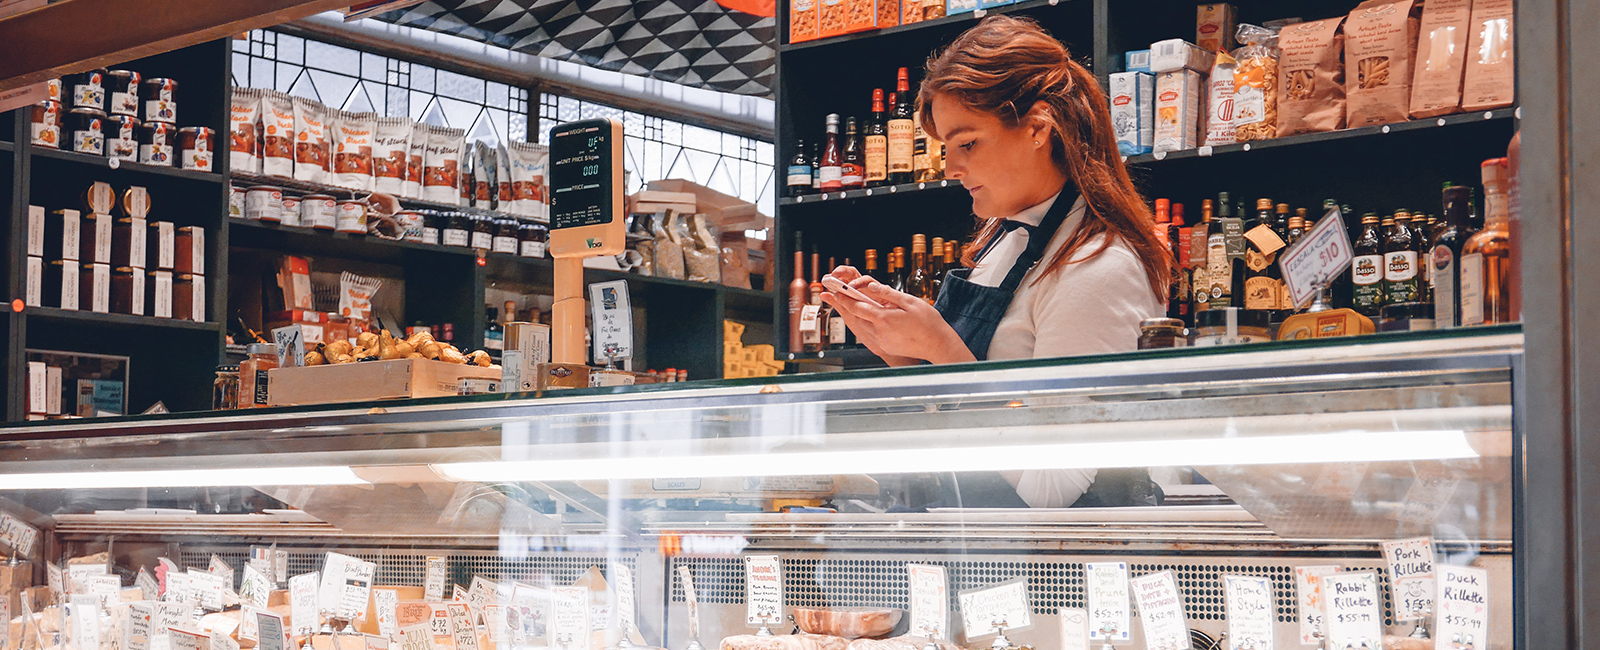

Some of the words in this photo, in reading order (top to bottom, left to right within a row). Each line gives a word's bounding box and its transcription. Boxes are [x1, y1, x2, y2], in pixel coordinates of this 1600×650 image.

[341, 126, 370, 136] Chicken
[551, 197, 557, 205] $
[1319, 241, 1339, 268] $10
[1394, 547, 1421, 561] Pork
[1394, 562, 1432, 578] Rillette
[1446, 572, 1479, 587] Duck
[1094, 586, 1126, 598] Prune
[1235, 583, 1262, 597] Home
[1335, 583, 1367, 595] Rabbit
[1443, 586, 1485, 604] Rillette
[978, 591, 1010, 602] Chicken
[1237, 597, 1265, 615] Style
[1334, 597, 1374, 611] Rillette
